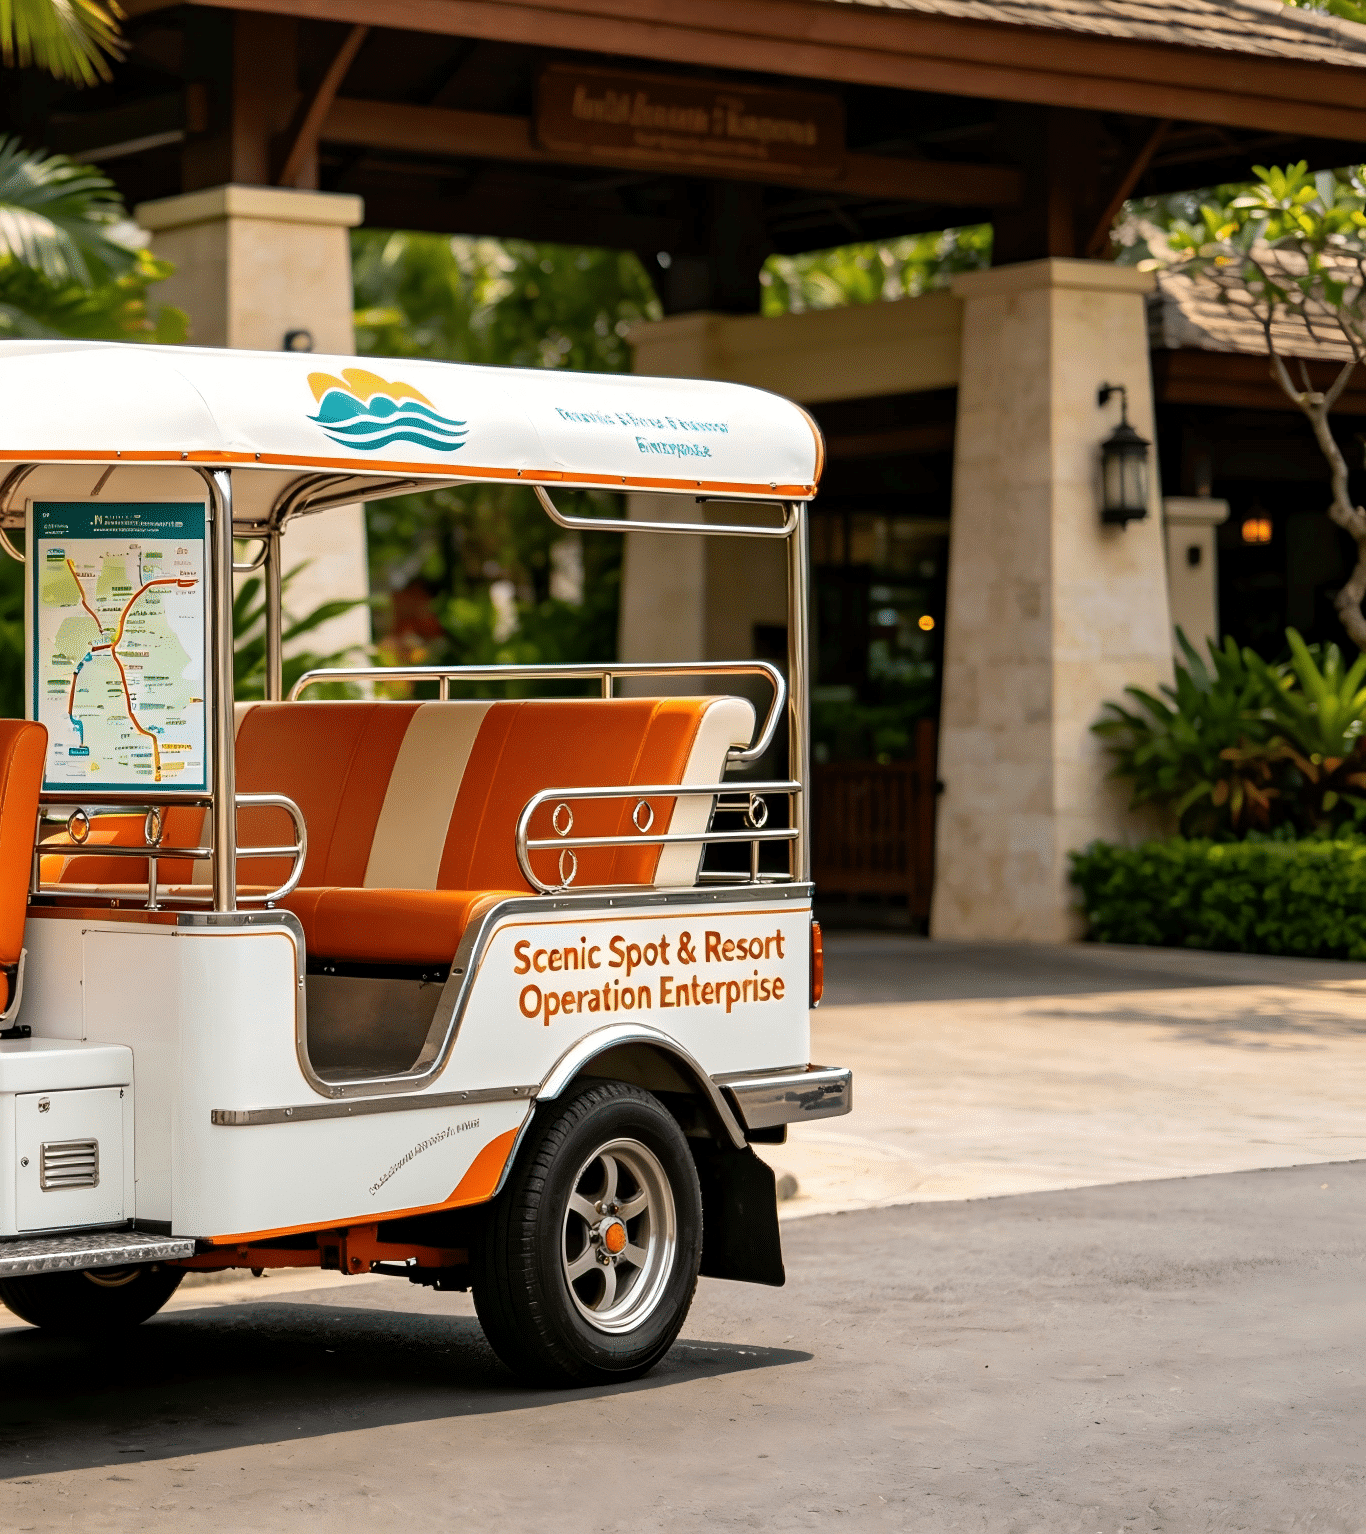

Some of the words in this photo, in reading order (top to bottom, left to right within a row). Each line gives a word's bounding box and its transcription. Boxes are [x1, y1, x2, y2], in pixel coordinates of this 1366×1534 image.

[513, 935, 601, 975] Scenic
[608, 934, 670, 977] Spot
[677, 931, 697, 965] &
[704, 929, 785, 963] Resort
[518, 978, 652, 1027] Operation
[659, 969, 785, 1014] Enterprise
